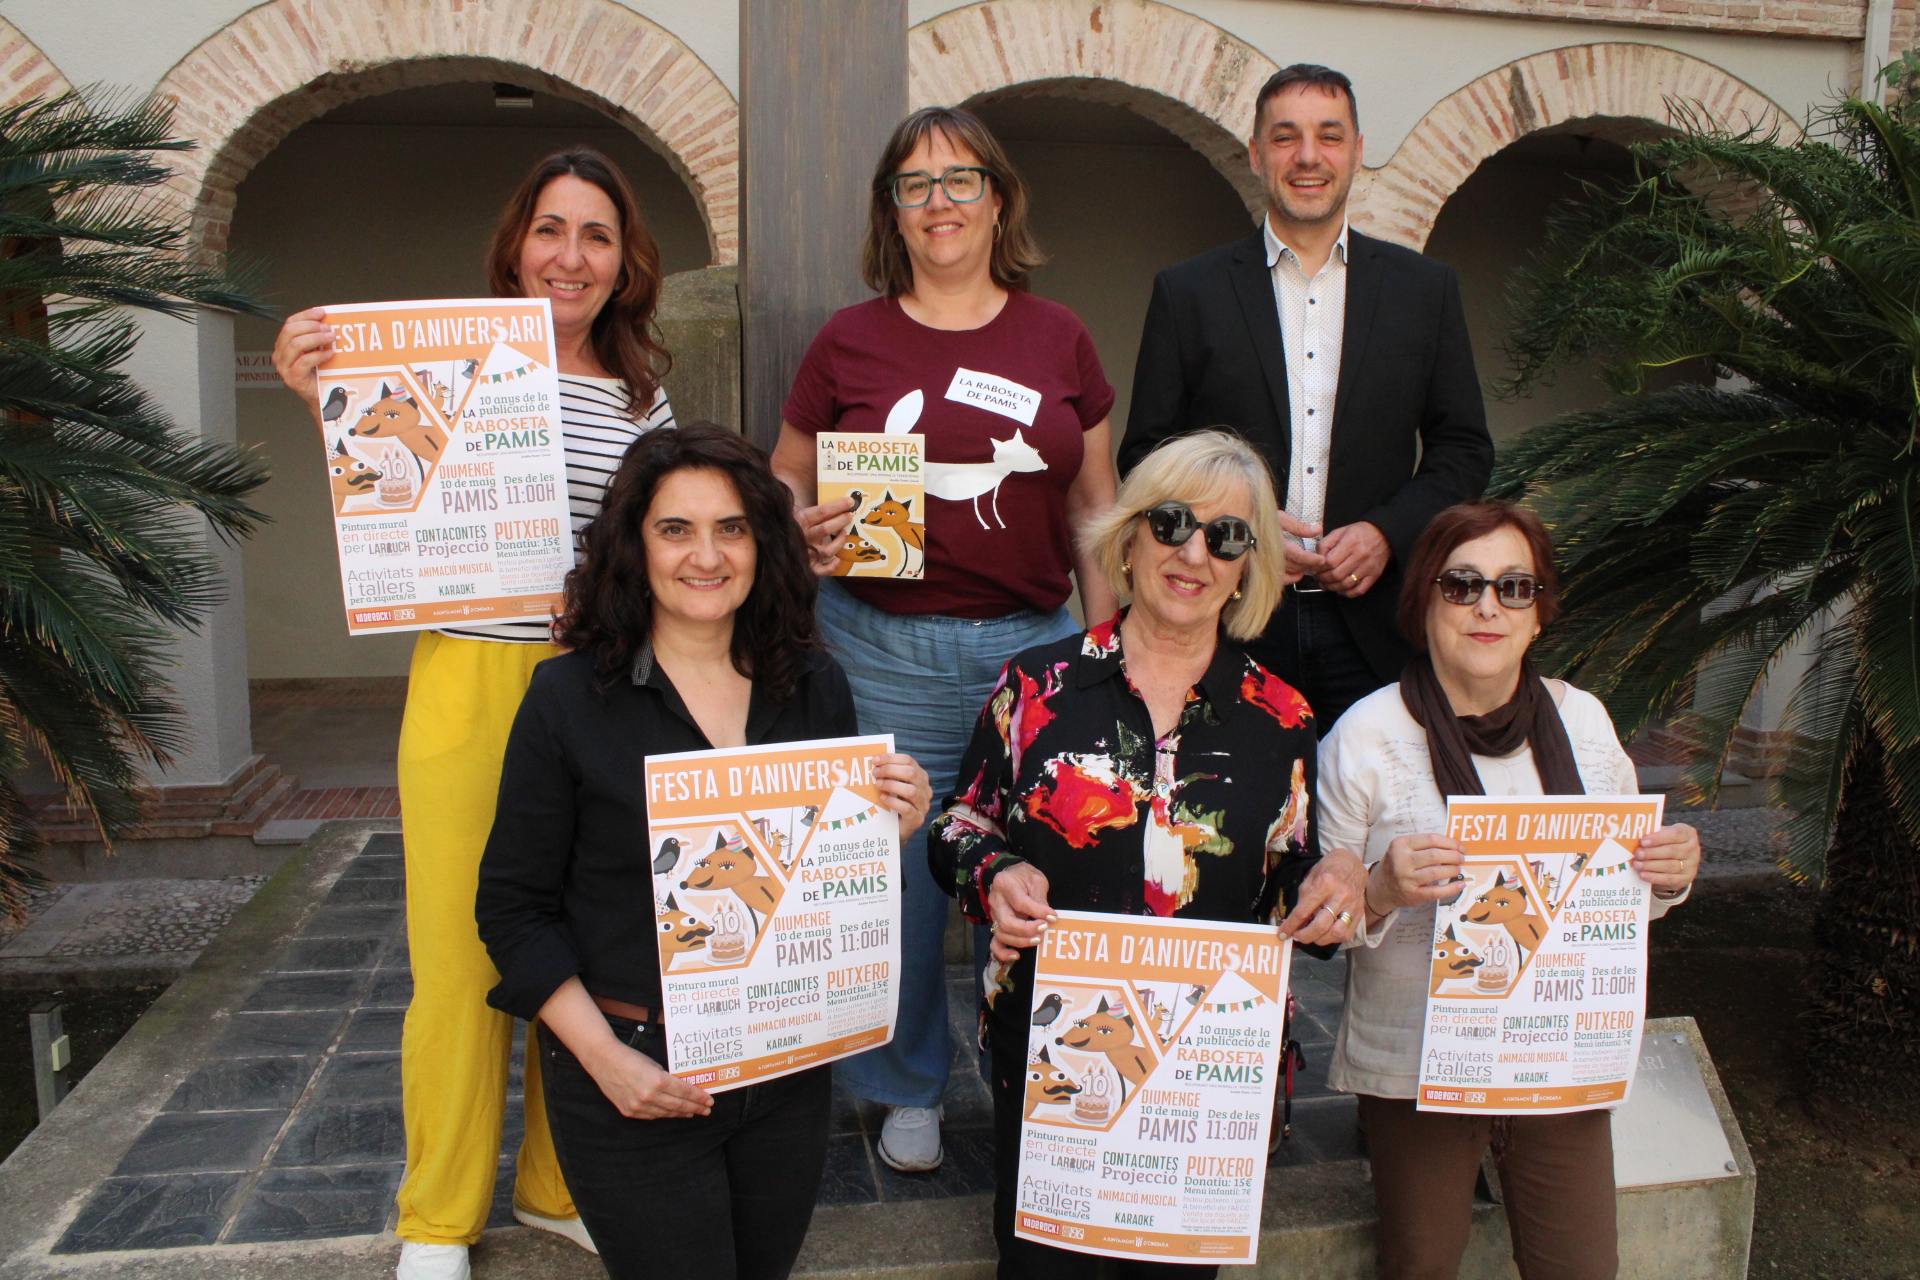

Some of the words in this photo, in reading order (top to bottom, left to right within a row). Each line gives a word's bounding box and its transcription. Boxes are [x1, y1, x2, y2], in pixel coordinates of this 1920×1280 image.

[331, 322, 383, 353] ESTA
[392, 315, 544, 348] D'ANIVERSARI
[480, 396, 492, 405] 10
[494, 396, 520, 405] anys
[523, 393, 535, 402] de
[538, 392, 548, 401] la
[959, 378, 972, 387] LA
[976, 382, 1031, 404] RABOSETA
[966, 390, 983, 400] DE
[984, 395, 1018, 410] PAMIS
[462, 409, 476, 419] LA
[480, 404, 535, 417] publicació
[538, 403, 550, 412] de
[464, 417, 547, 433] RABOSETA
[466, 441, 482, 452] DE
[486, 430, 549, 450] PAMIS
[822, 441, 834, 449] LA
[837, 441, 919, 455] RABOSETA
[440, 462, 494, 479] DIUMENGE
[837, 461, 853, 470] DE
[857, 455, 919, 472] PAMIS
[440, 480, 452, 490] 10
[454, 479, 467, 488] de
[470, 477, 496, 488] maig
[504, 476, 523, 484] Des
[525, 474, 538, 483] de
[540, 473, 555, 482] les
[443, 489, 497, 513] PAMIS
[506, 484, 555, 504] 11:00H
[416, 525, 486, 543] CONTACONTES
[495, 518, 558, 540] PUTXERO
[418, 539, 488, 558] Projecció
[496, 540, 539, 550] Donatiu:
[543, 537, 560, 546] 15€
[419, 565, 457, 577] ANIMACIÓ
[459, 563, 493, 574] MUSICAL
[439, 584, 475, 596] KARAOKE
[650, 768, 719, 803] FESTA
[729, 756, 877, 797] D'ANIVERSAR
[1450, 814, 1507, 841] FESTA
[1516, 813, 1653, 841] D'ANIVERSARI
[819, 843, 831, 853] 10
[834, 843, 860, 852] anys
[862, 839, 875, 849] de
[877, 838, 888, 847] la
[800, 858, 814, 868] LA
[819, 849, 874, 866] publicació
[877, 848, 890, 857] de
[802, 862, 886, 882] RABOSETA
[803, 890, 820, 902] DE
[823, 875, 887, 899] PAMIS
[1581, 888, 1592, 897] 10
[1594, 890, 1616, 898] anys
[1619, 887, 1630, 896] de
[1632, 887, 1641, 898] la
[1564, 900, 1576, 910] LA
[1580, 898, 1628, 909] publicació
[1630, 898, 1642, 906] de
[775, 911, 830, 931] DIUMENGE
[1564, 910, 1636, 923] RABOSETA
[840, 924, 859, 933] Des
[861, 920, 873, 930] de
[876, 918, 890, 928] les
[1563, 932, 1578, 942] DE
[1581, 923, 1636, 941] PAMIS
[775, 932, 787, 943] 10
[789, 930, 802, 941] de
[805, 927, 831, 938] maig
[841, 928, 888, 952] 11:00H
[777, 938, 832, 967] PAMIS
[1042, 928, 1108, 962] FESTA
[1120, 935, 1279, 974] D'ANIVERSARI
[1536, 953, 1585, 967] DIUMENGE
[828, 962, 889, 989] PUTXERO
[1535, 969, 1545, 978] 10
[1547, 968, 1559, 978] de
[1561, 968, 1584, 978] maig
[1593, 968, 1609, 976] Des
[1611, 966, 1622, 975] de
[1624, 966, 1637, 975] les
[748, 976, 818, 999] CONTACONTES
[827, 985, 869, 999] Donatiu:
[872, 979, 889, 989] 15€
[1534, 979, 1584, 1002] PAMIS
[1592, 976, 1635, 995] 11:00H
[748, 989, 819, 1013] Projecció
[748, 1018, 786, 1034] ANIMACIÓ
[789, 1012, 822, 1026] MUSICAL
[1504, 1015, 1568, 1029] CONTACONTES
[1576, 1011, 1633, 1030] PUTXERO
[1199, 1025, 1212, 1034] 10
[1214, 1028, 1241, 1038] anys
[1244, 1027, 1257, 1037] de
[1260, 1028, 1270, 1038] la
[1503, 1028, 1568, 1046] Projecció
[1575, 1031, 1614, 1040] Donatiu:
[1617, 1030, 1632, 1038] 15€
[767, 1034, 802, 1050] KARAOKE
[1178, 1036, 1192, 1046] LA
[1197, 1036, 1254, 1047] publicació
[1257, 1040, 1271, 1048] de
[1178, 1048, 1263, 1064] RABOSETA
[1499, 1053, 1534, 1062] ANIMACIÓ
[1537, 1052, 1568, 1062] MUSICAL
[1175, 1070, 1192, 1081] DE
[1197, 1064, 1262, 1083] PAMIS
[1514, 1072, 1548, 1082] KARAOKE
[1081, 1074, 1108, 1097] 10
[1142, 1090, 1200, 1107] DIUMENGE
[1141, 1105, 1152, 1115] 10
[1155, 1106, 1168, 1116] de
[1171, 1108, 1198, 1120] maig
[1208, 1110, 1227, 1119] Des
[1230, 1110, 1243, 1120] de
[1245, 1110, 1260, 1120] les
[1028, 1130, 1064, 1142] Pintura
[1067, 1137, 1096, 1146] mural
[1139, 1117, 1197, 1143] PAMIS
[1207, 1120, 1257, 1140] 11:00H
[1026, 1140, 1043, 1150] en
[1048, 1142, 1096, 1157] directe
[1026, 1150, 1048, 1162] per
[1104, 1152, 1178, 1170] CONTACONTES
[1187, 1156, 1253, 1176] PUTXERO
[1102, 1166, 1177, 1185] Projecció
[1185, 1176, 1230, 1187] Donatiu:
[1234, 1178, 1252, 1187] 15€
[1024, 1176, 1091, 1197] Activitats
[1022, 1201, 1036, 1210] per
[1033, 1190, 1090, 1212] tallers
[1098, 1190, 1138, 1203] ANIMACIÓ
[1141, 1194, 1176, 1206] MUSICAL
[1115, 1213, 1154, 1226] KARAOKE
